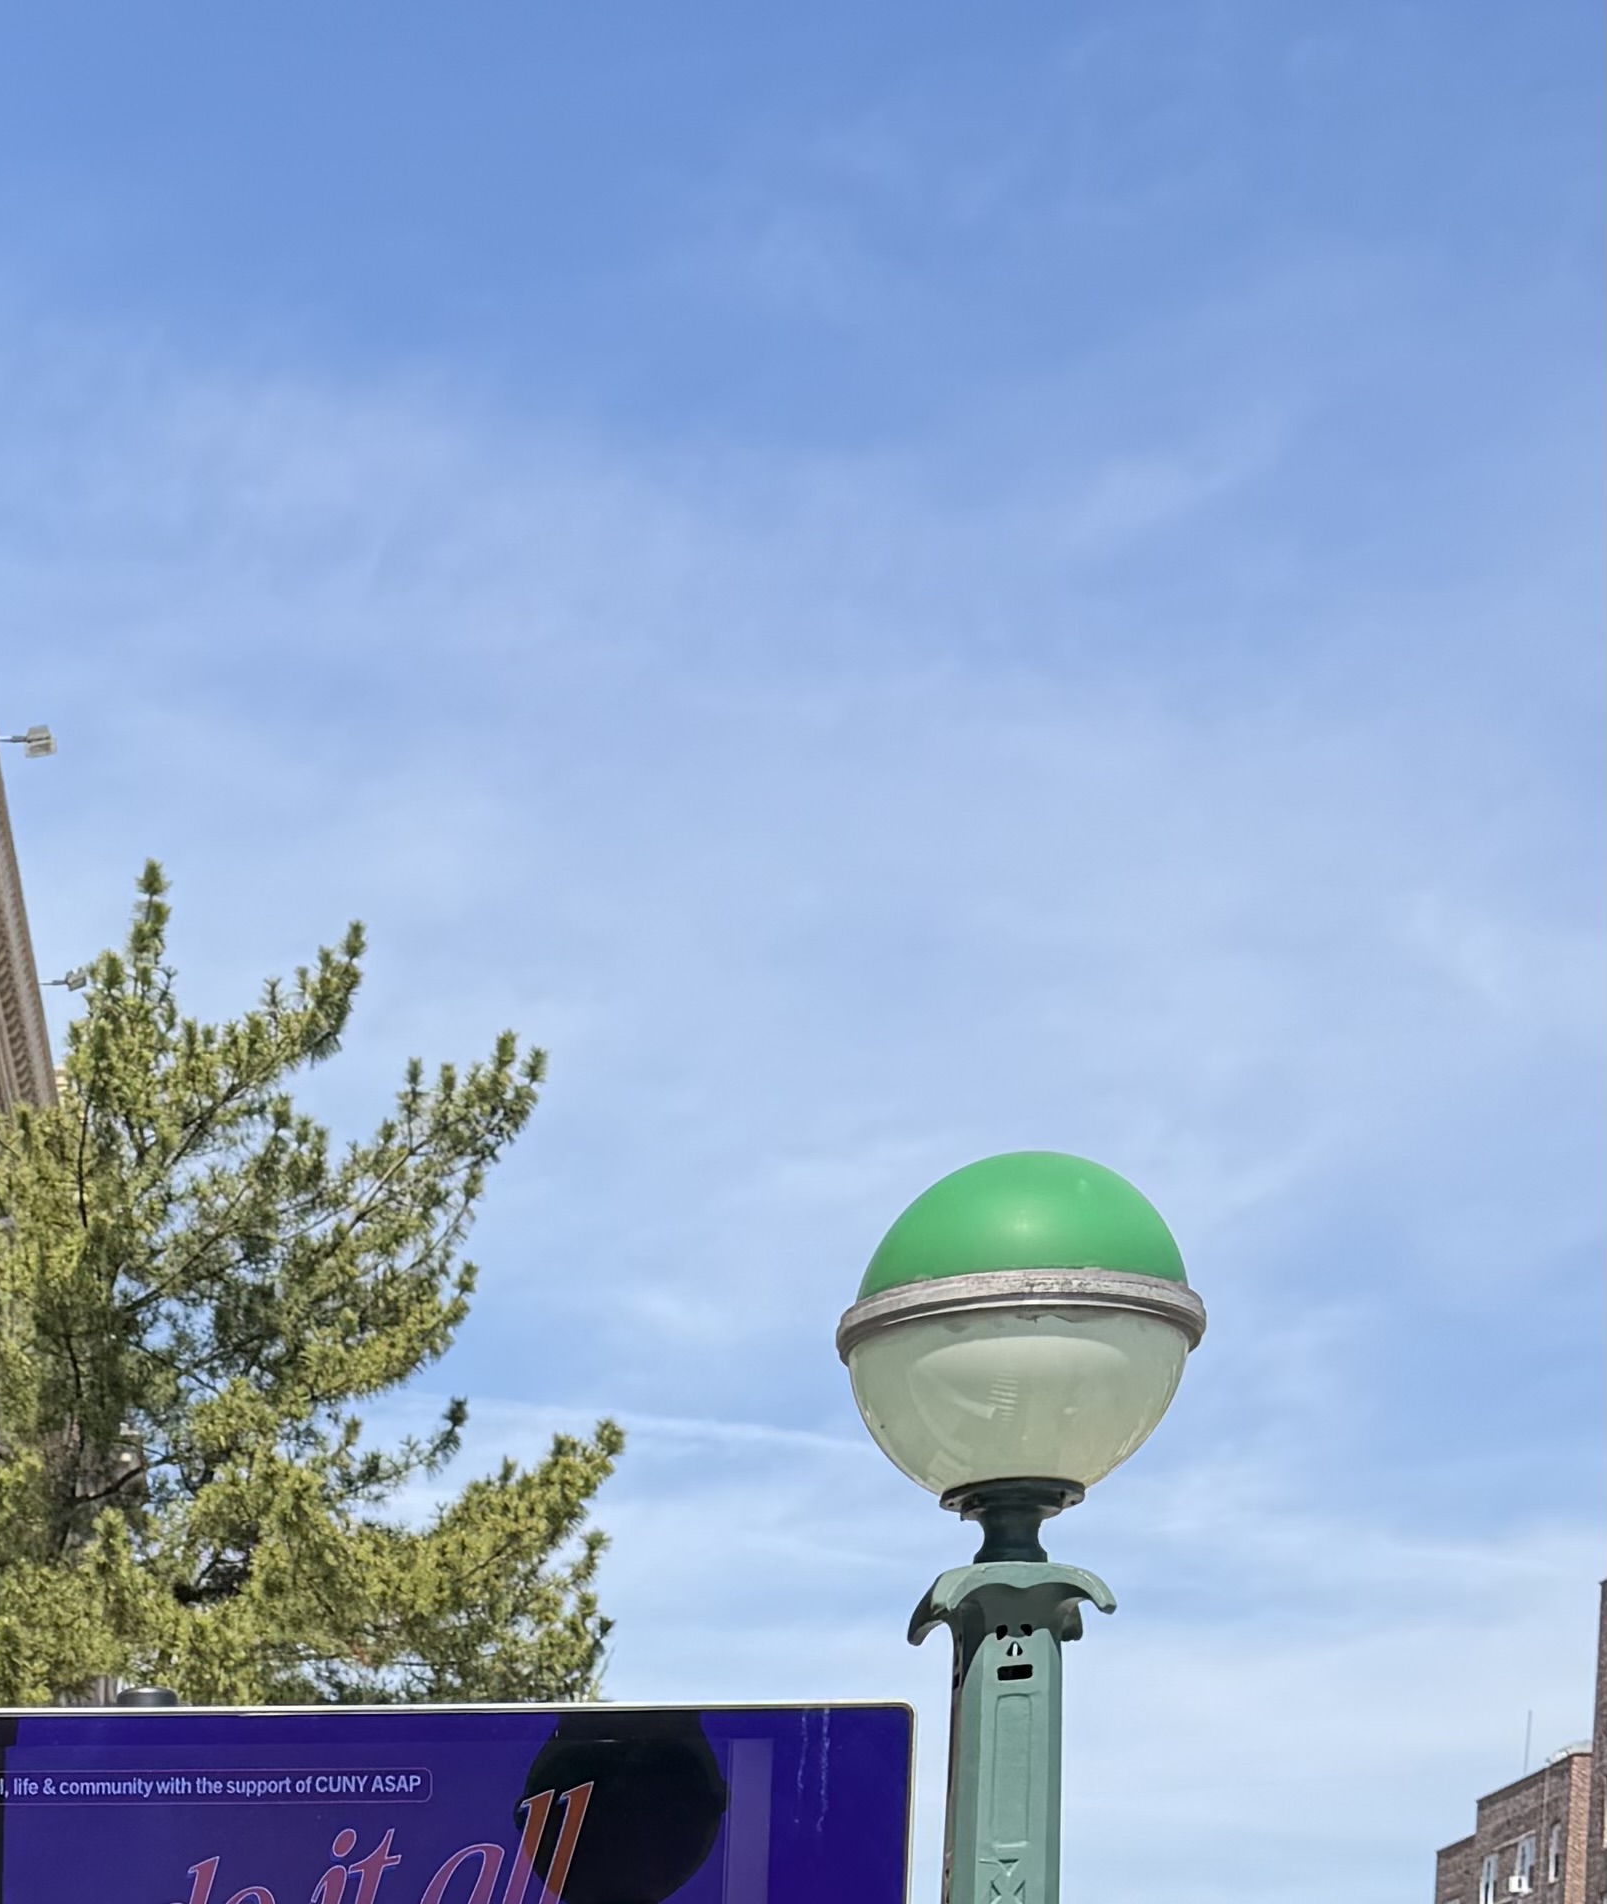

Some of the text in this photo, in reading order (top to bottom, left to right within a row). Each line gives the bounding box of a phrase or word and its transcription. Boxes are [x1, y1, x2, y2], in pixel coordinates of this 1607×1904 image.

[13, 1777, 39, 1795] life
[42, 1778, 57, 1795] &
[59, 1776, 154, 1799] community
[156, 1776, 192, 1795] with
[196, 1776, 223, 1794] the
[226, 1776, 292, 1797] support
[295, 1775, 312, 1794] of
[315, 1775, 369, 1793] CUNY
[370, 1774, 422, 1793] ASAP
